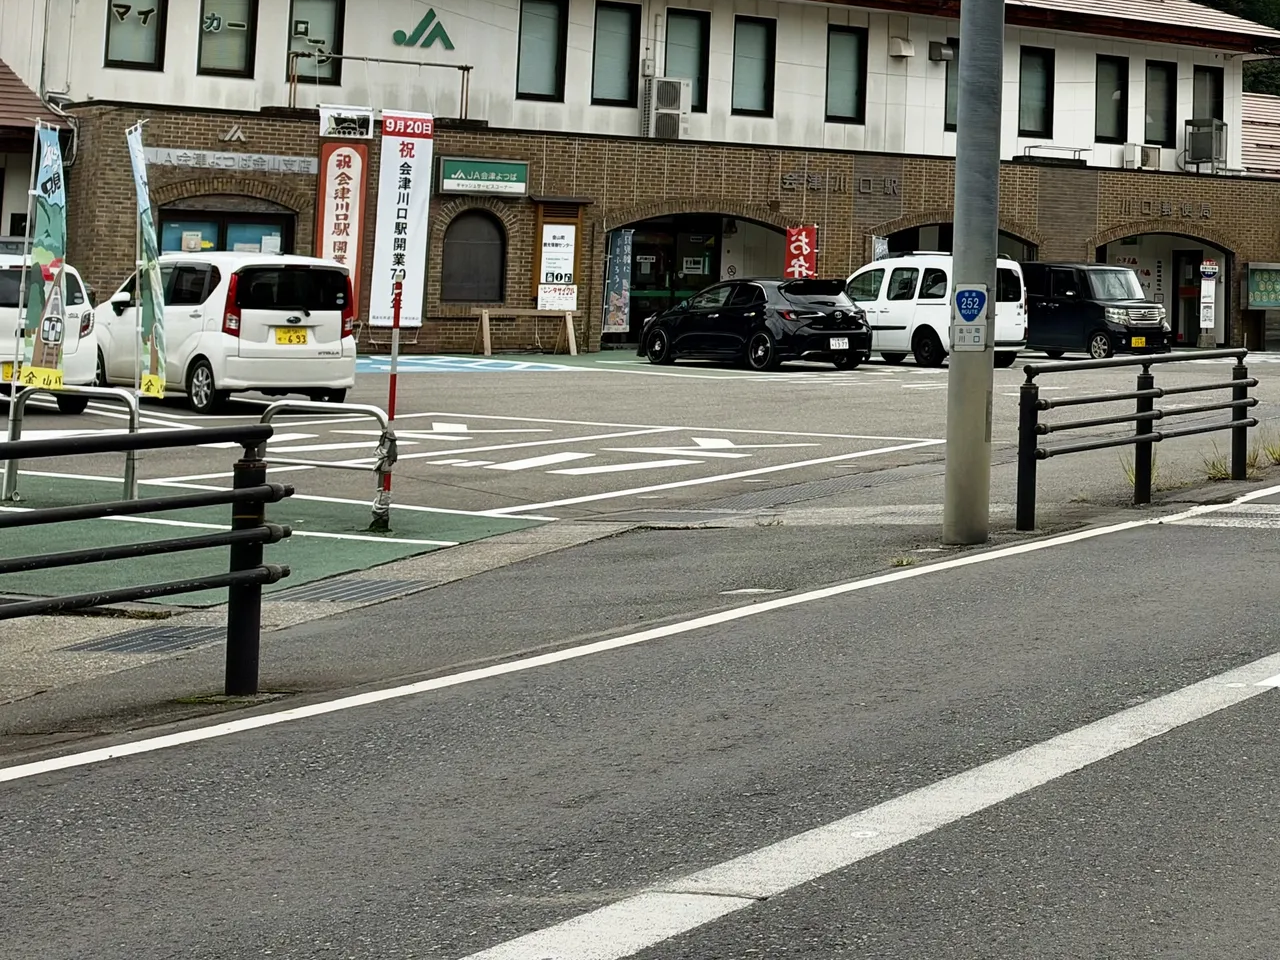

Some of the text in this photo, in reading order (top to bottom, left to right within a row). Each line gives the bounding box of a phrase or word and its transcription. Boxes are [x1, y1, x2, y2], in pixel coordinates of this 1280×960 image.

[112, 3, 156, 25] マイ
[203, 12, 247, 32] カー
[385, 118, 432, 135] 9月20日
[399, 141, 415, 159] 祝
[467, 170, 517, 181] JA会津よつば
[781, 173, 898, 196] 会津川口駅
[1121, 199, 1212, 218] 川口郵便局
[961, 297, 979, 309] 252
